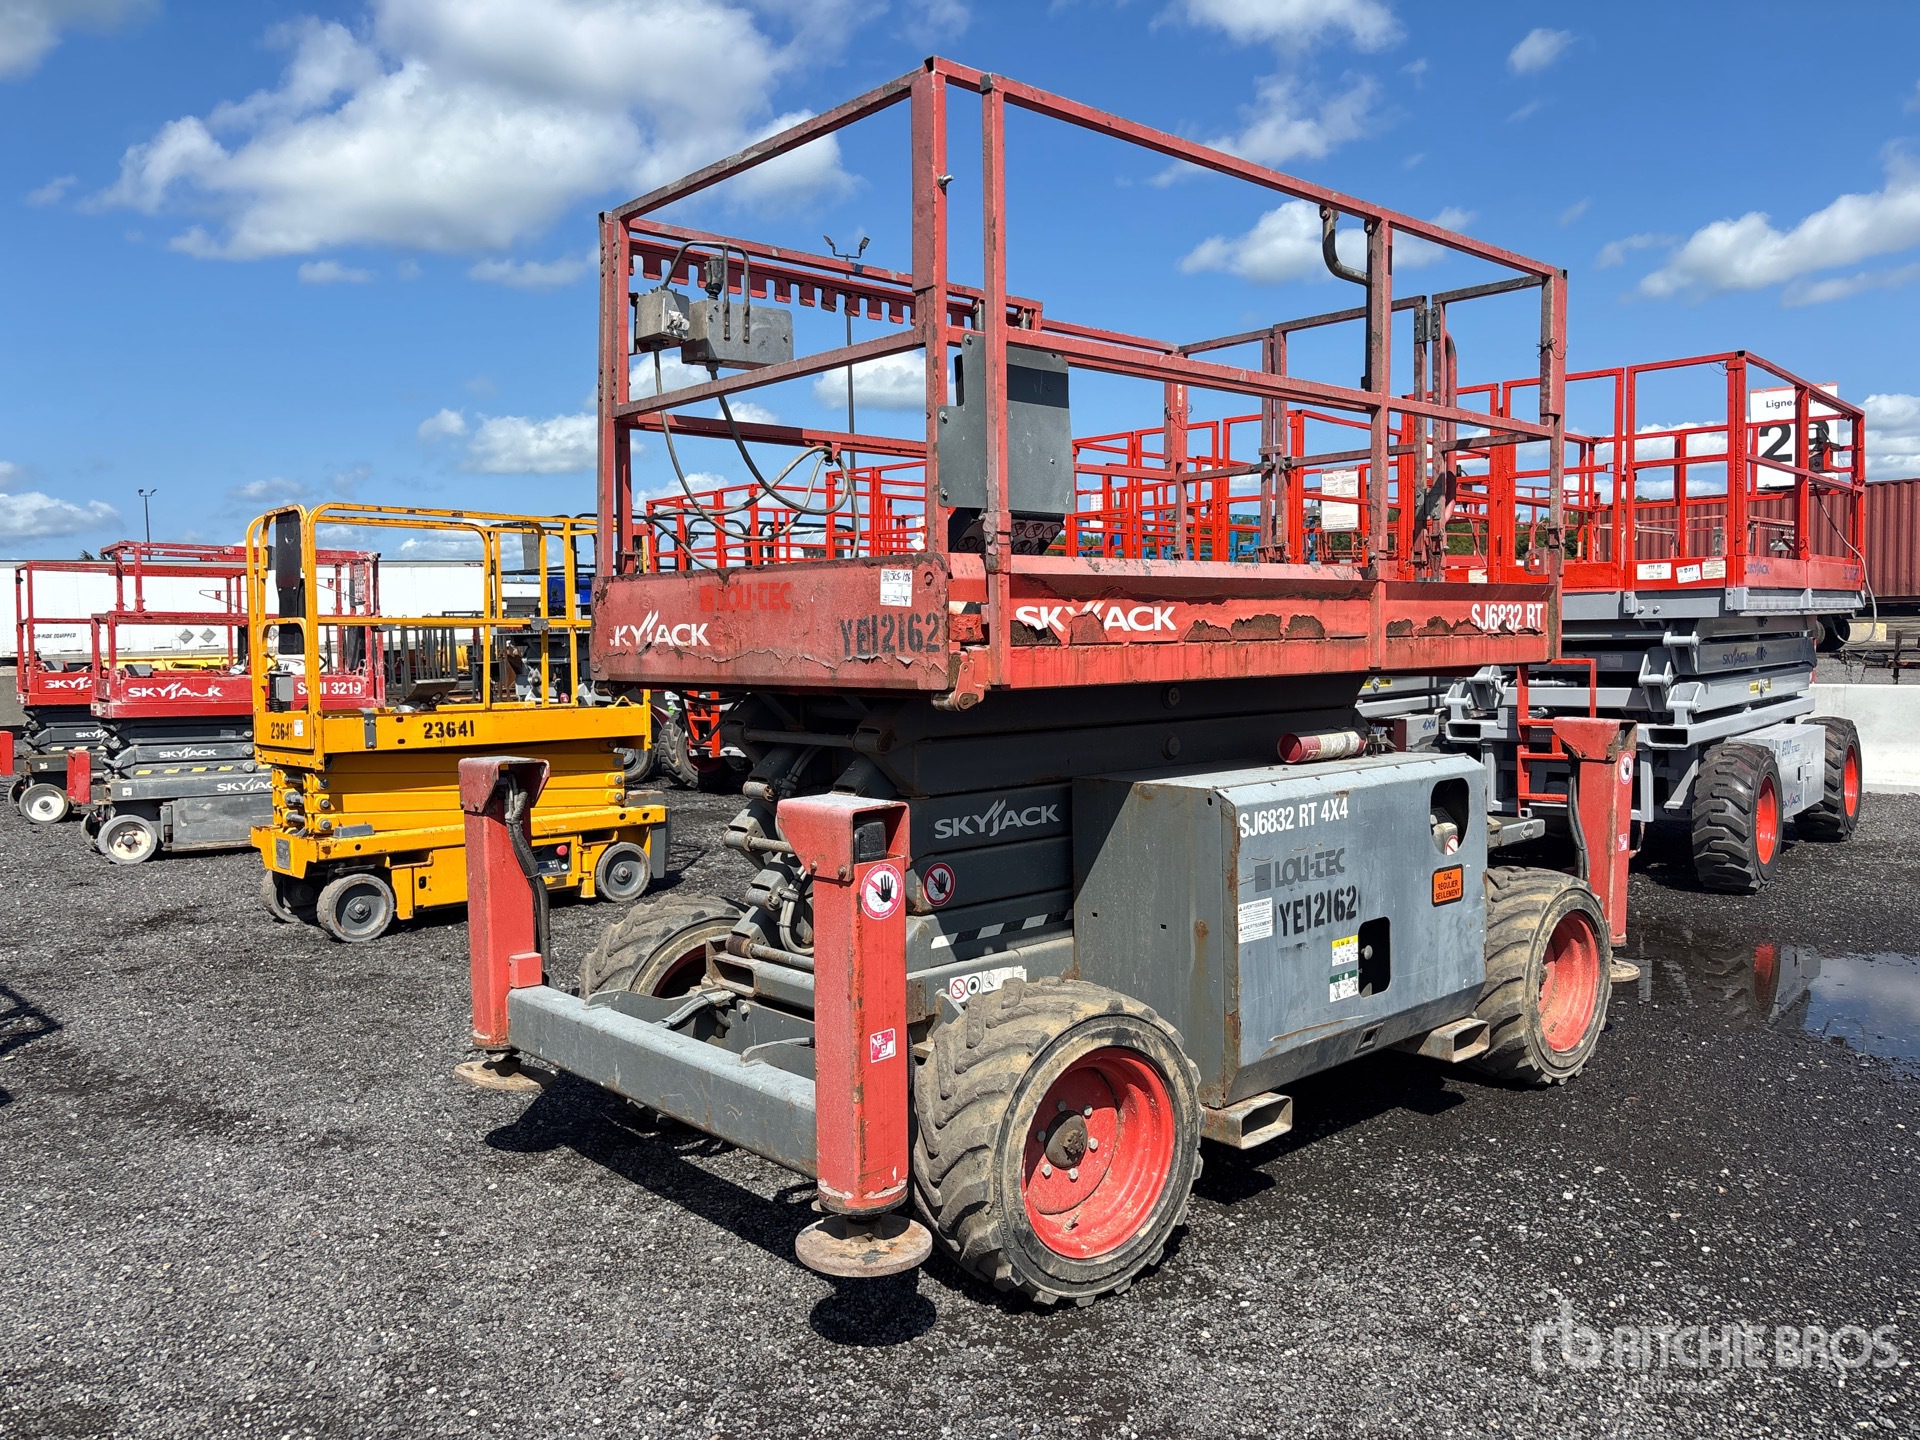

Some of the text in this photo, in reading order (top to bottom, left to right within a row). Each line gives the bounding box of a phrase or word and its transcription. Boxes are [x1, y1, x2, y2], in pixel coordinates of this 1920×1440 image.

[609, 609, 711, 647] KYJACK
[1471, 603, 1544, 631] SJ6832 RT
[840, 612, 940, 657] YE12162
[330, 682, 362, 695] 3219
[423, 719, 475, 740] 23641
[158, 747, 217, 758] SKYJACK
[934, 798, 1060, 839] SKYJACK
[1239, 796, 1349, 839] SJ6832 RT 4X4
[1274, 847, 1346, 888] LOU-TEC
[1443, 871, 1453, 881] GAZ
[1278, 884, 1357, 937] YE12162
[1435, 888, 1461, 901] SEULEMENT
